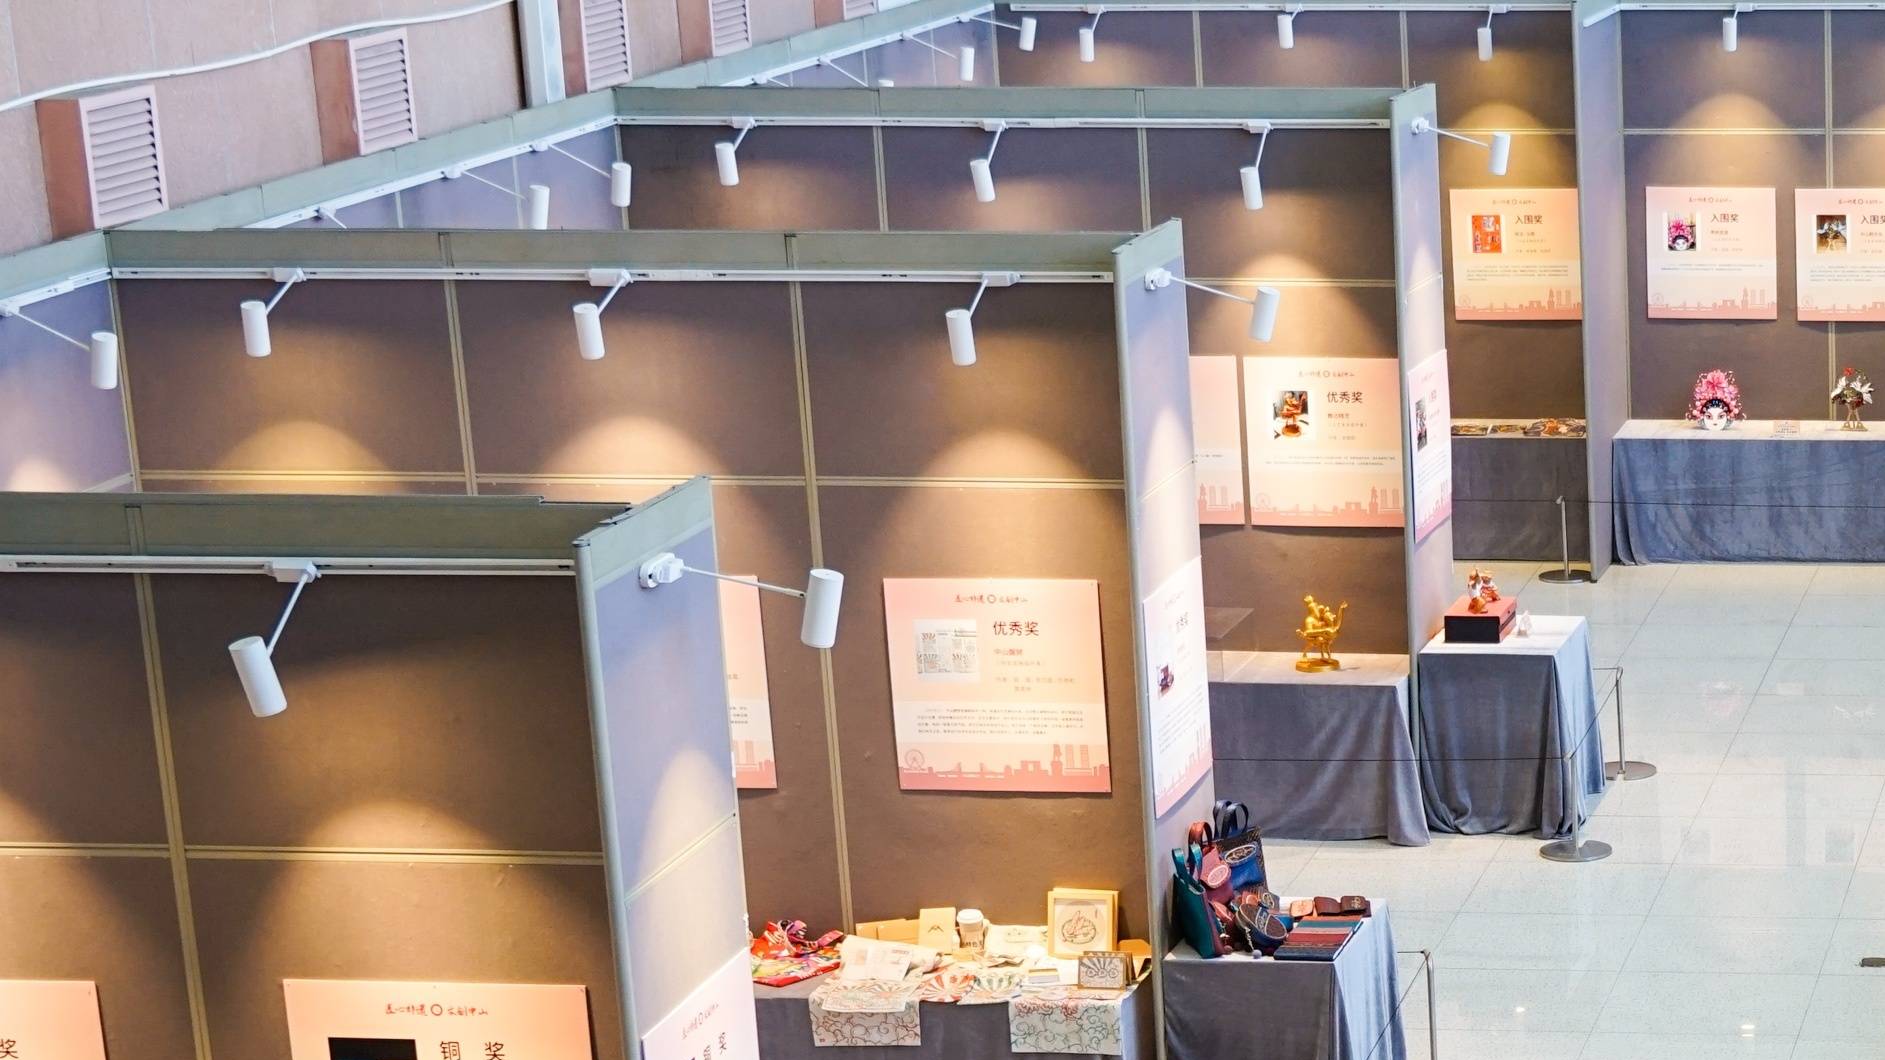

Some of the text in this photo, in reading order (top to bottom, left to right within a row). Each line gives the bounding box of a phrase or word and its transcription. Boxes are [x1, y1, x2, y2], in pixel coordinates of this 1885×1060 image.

[1514, 214, 1543, 225] 入围奖
[1710, 212, 1738, 223] 入围奖
[1327, 391, 1363, 404] 优秀奖
[992, 620, 1040, 637] 优秀奖
